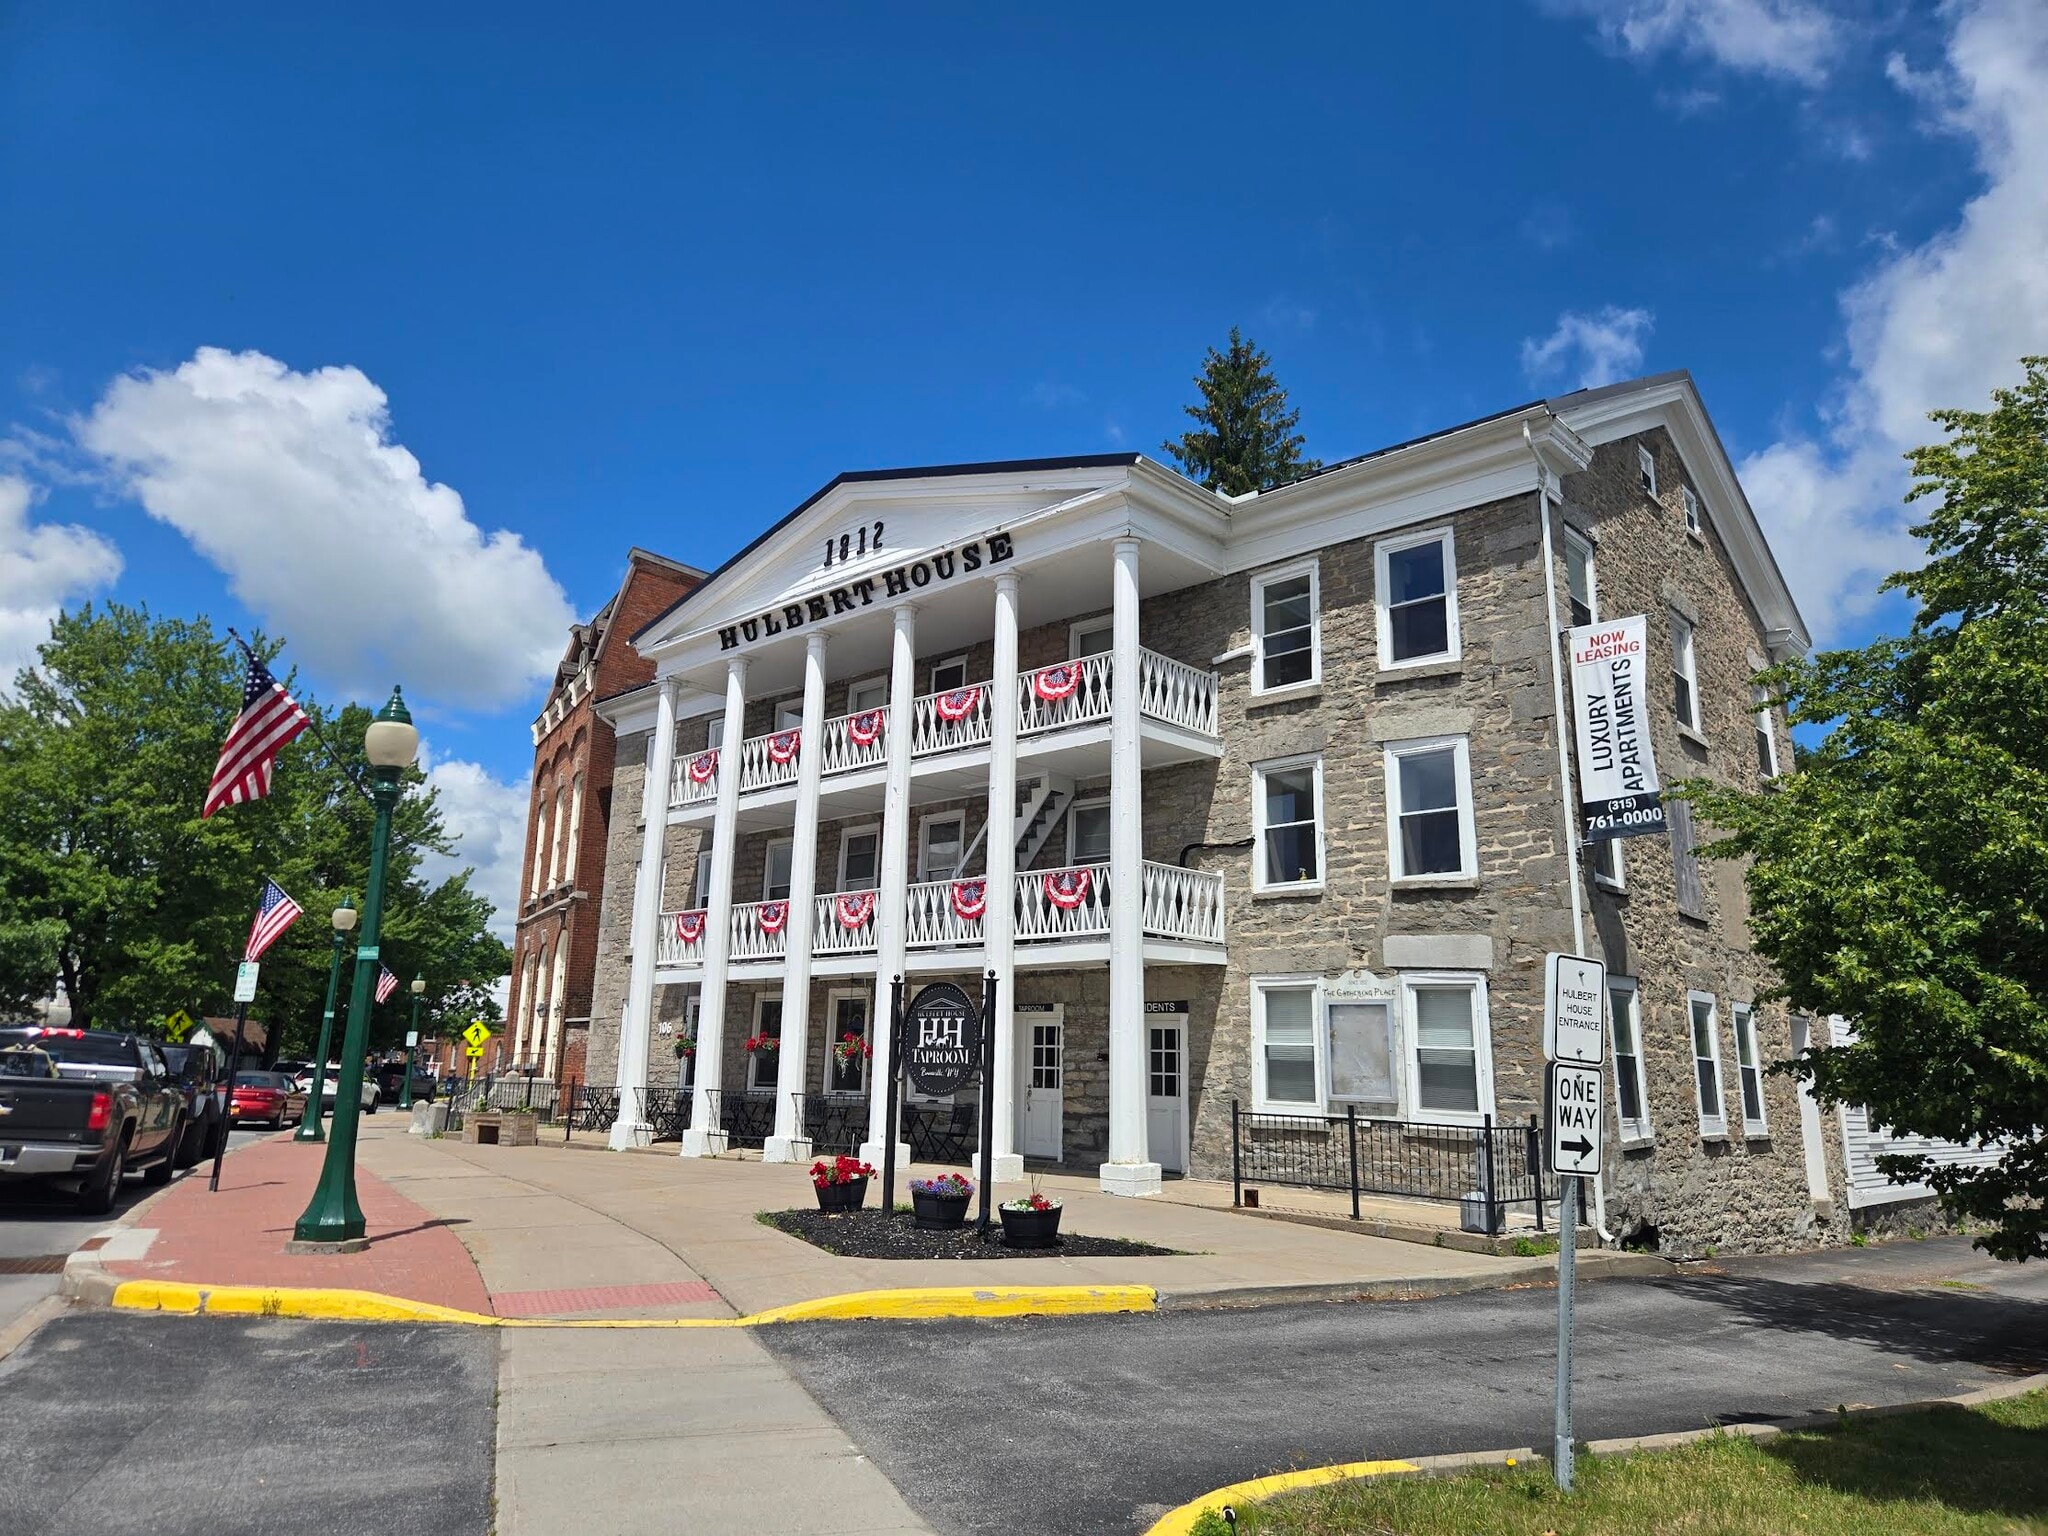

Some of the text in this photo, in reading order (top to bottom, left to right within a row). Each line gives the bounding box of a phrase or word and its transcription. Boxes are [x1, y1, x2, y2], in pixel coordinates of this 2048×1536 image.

[824, 521, 884, 567] 1812
[718, 532, 1014, 651] HULBERT HOUSE
[1590, 630, 1625, 648] NOW
[1576, 640, 1640, 664] LEASING
[1588, 694, 1613, 771] LUXURY
[1612, 658, 1645, 791] APARTMENTS
[1608, 797, 1636, 812] (315)
[1587, 807, 1662, 830] 761-0000
[1562, 988, 1597, 1002] HULBERT
[1144, 1002, 1175, 1012] IDENTS
[1567, 1004, 1593, 1016] HOUSE
[658, 1021, 672, 1034] 106
[917, 1018, 965, 1048] HH
[1559, 1016, 1600, 1031] ENTRANCE
[912, 1048, 969, 1064] TAPROOM
[1560, 1078, 1596, 1103] ONE
[1559, 1105, 1597, 1130] WAY
